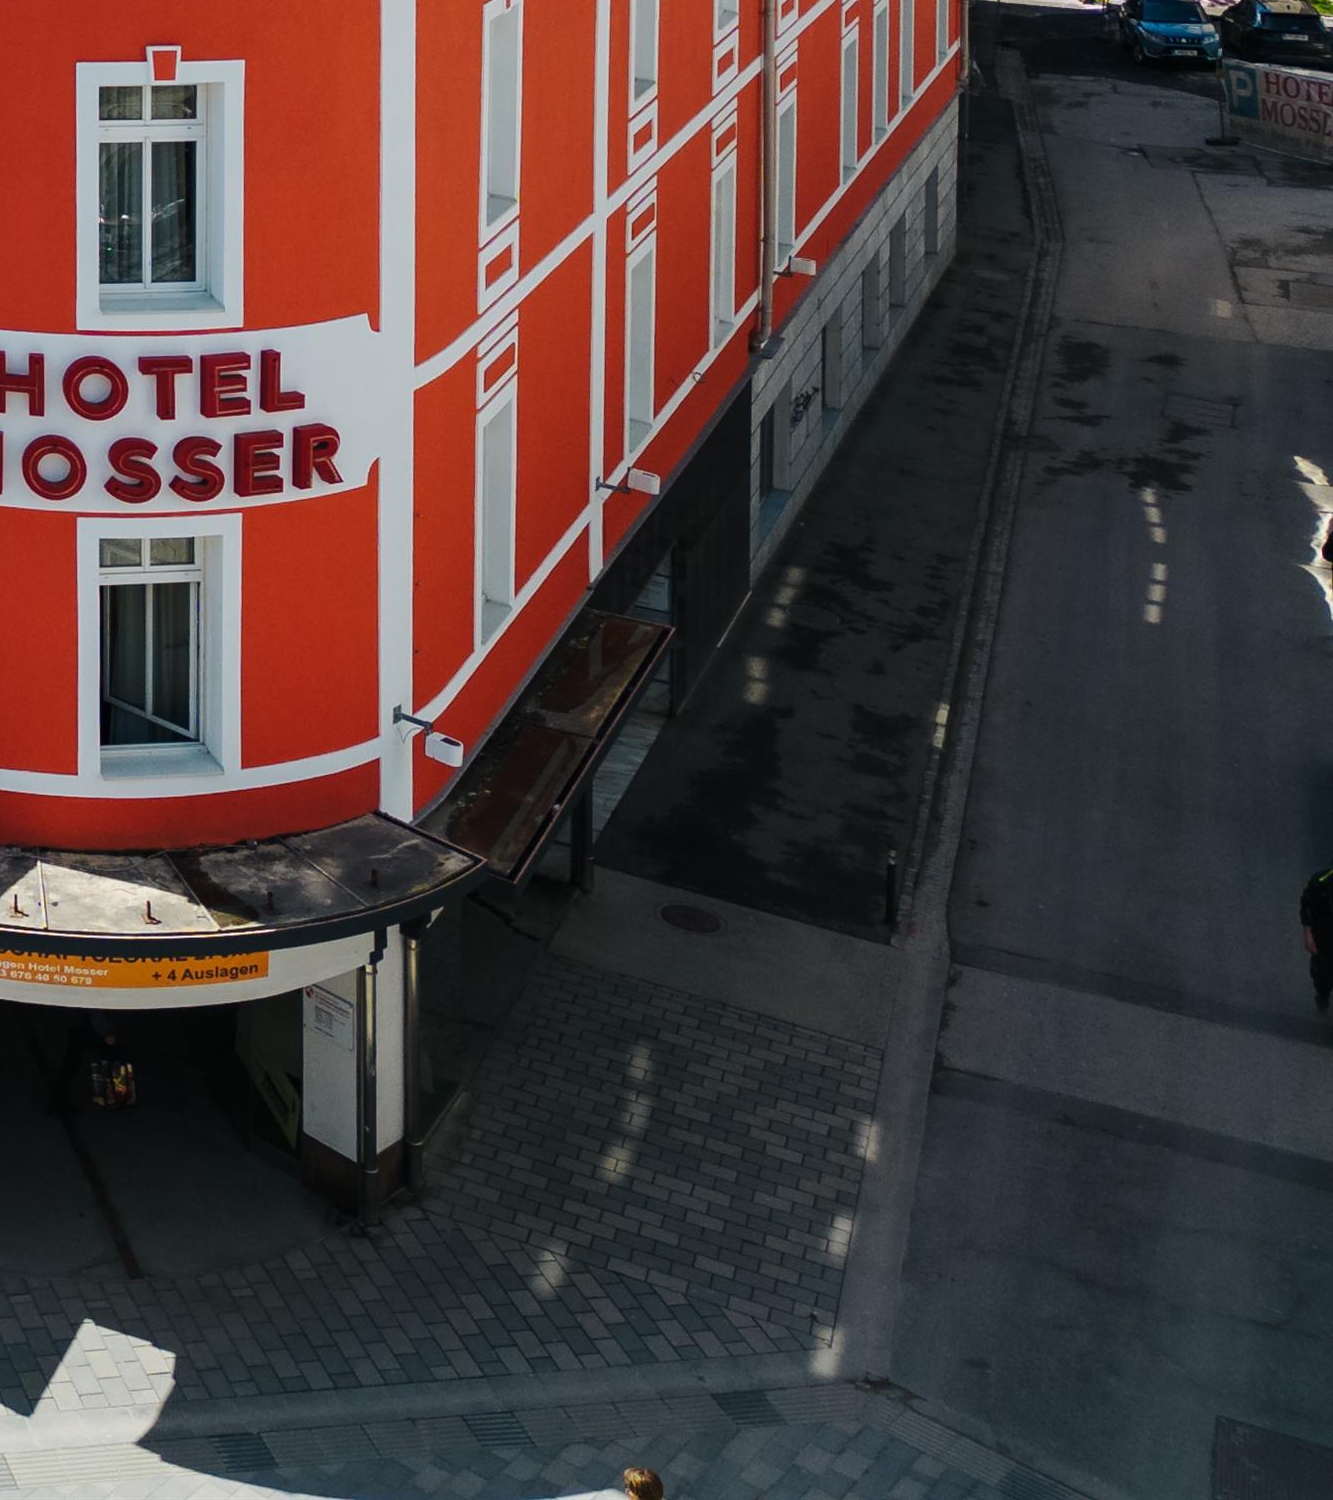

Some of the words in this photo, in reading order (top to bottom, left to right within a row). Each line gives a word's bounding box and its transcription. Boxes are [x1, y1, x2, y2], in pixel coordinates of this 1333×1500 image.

[1263, 71, 1333, 107] HOTE
[28, 961, 61, 973] Hotel
[152, 971, 162, 980] +
[167, 969, 177, 981] 4
[181, 964, 259, 980] Auslagen
